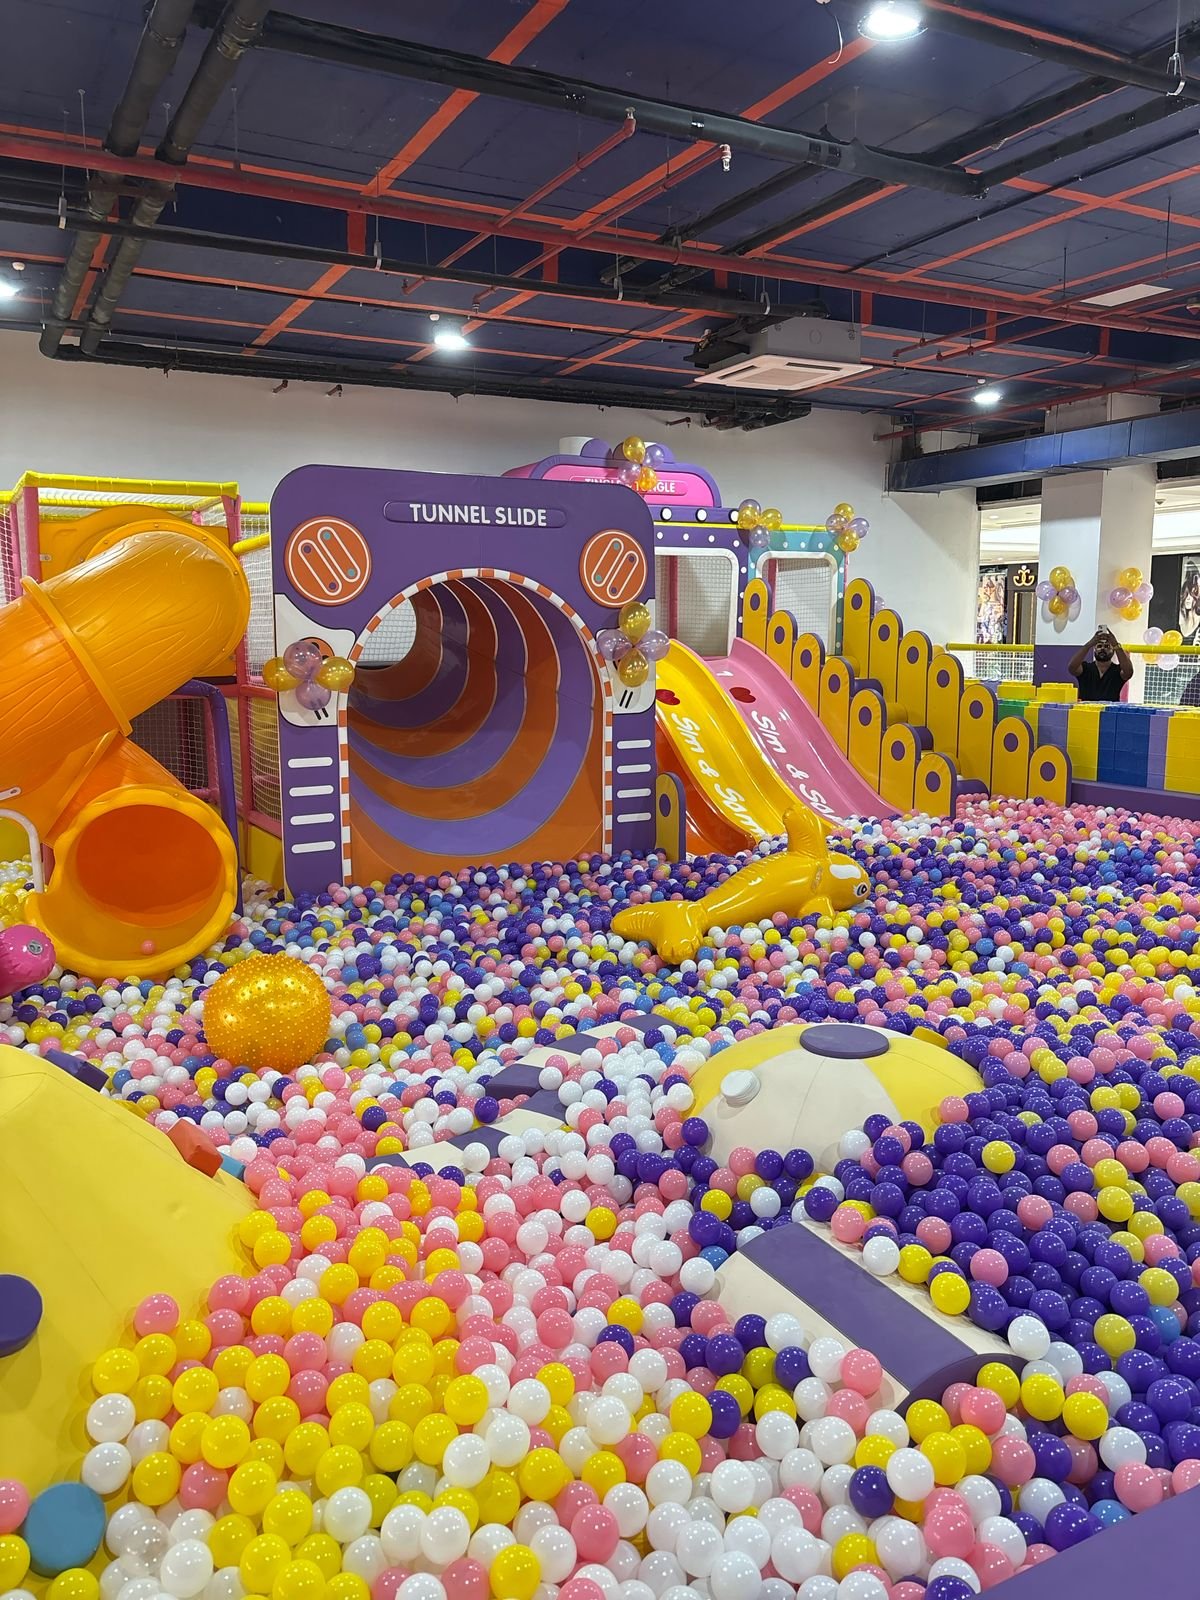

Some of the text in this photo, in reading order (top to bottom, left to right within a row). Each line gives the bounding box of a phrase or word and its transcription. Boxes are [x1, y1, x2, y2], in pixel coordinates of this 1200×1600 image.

[409, 503, 547, 526] TUNNEL SLIDE
[698, 759, 720, 778] &
[786, 763, 809, 780] &
